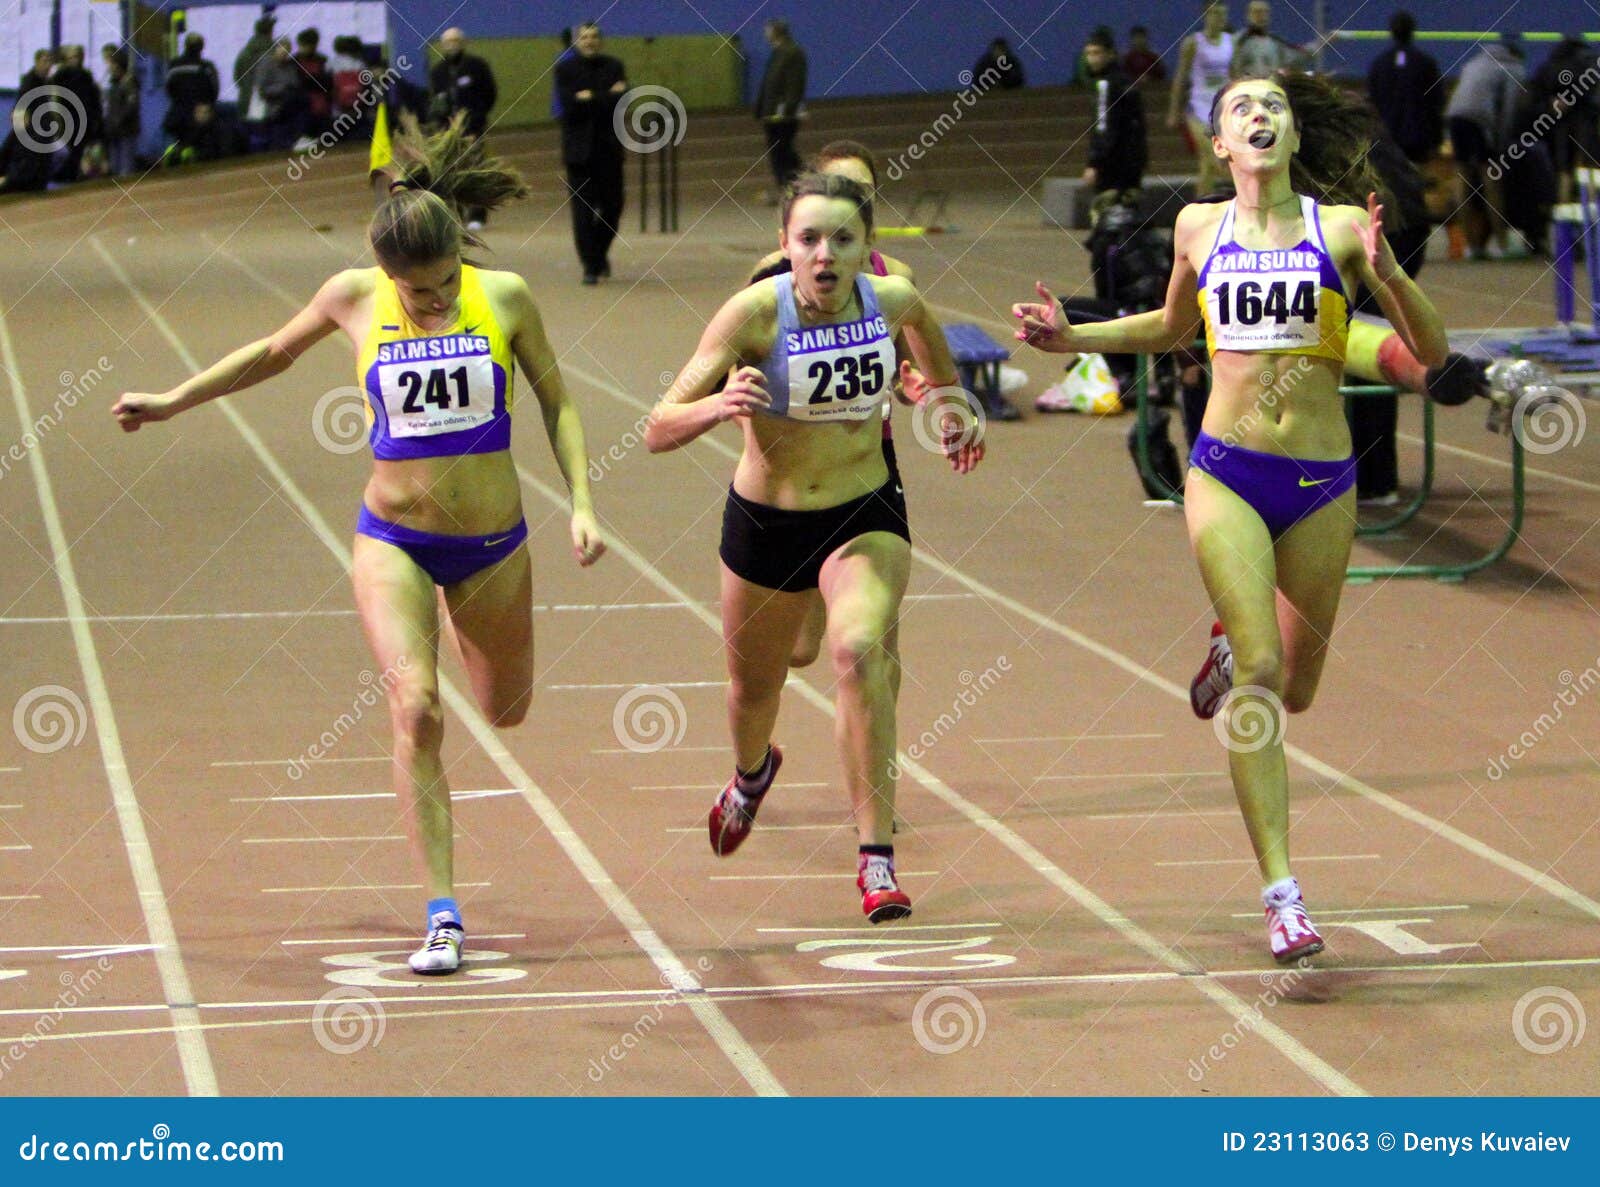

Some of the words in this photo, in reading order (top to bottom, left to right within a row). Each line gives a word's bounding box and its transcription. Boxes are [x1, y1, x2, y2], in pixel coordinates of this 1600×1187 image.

[1211, 251, 1319, 272] SAMSUNG
[1213, 281, 1318, 325] 1644
[379, 336, 489, 362] SAMSUNG
[786, 316, 888, 352] SAMSUNG
[398, 366, 470, 414] 241
[808, 351, 884, 404] 235
